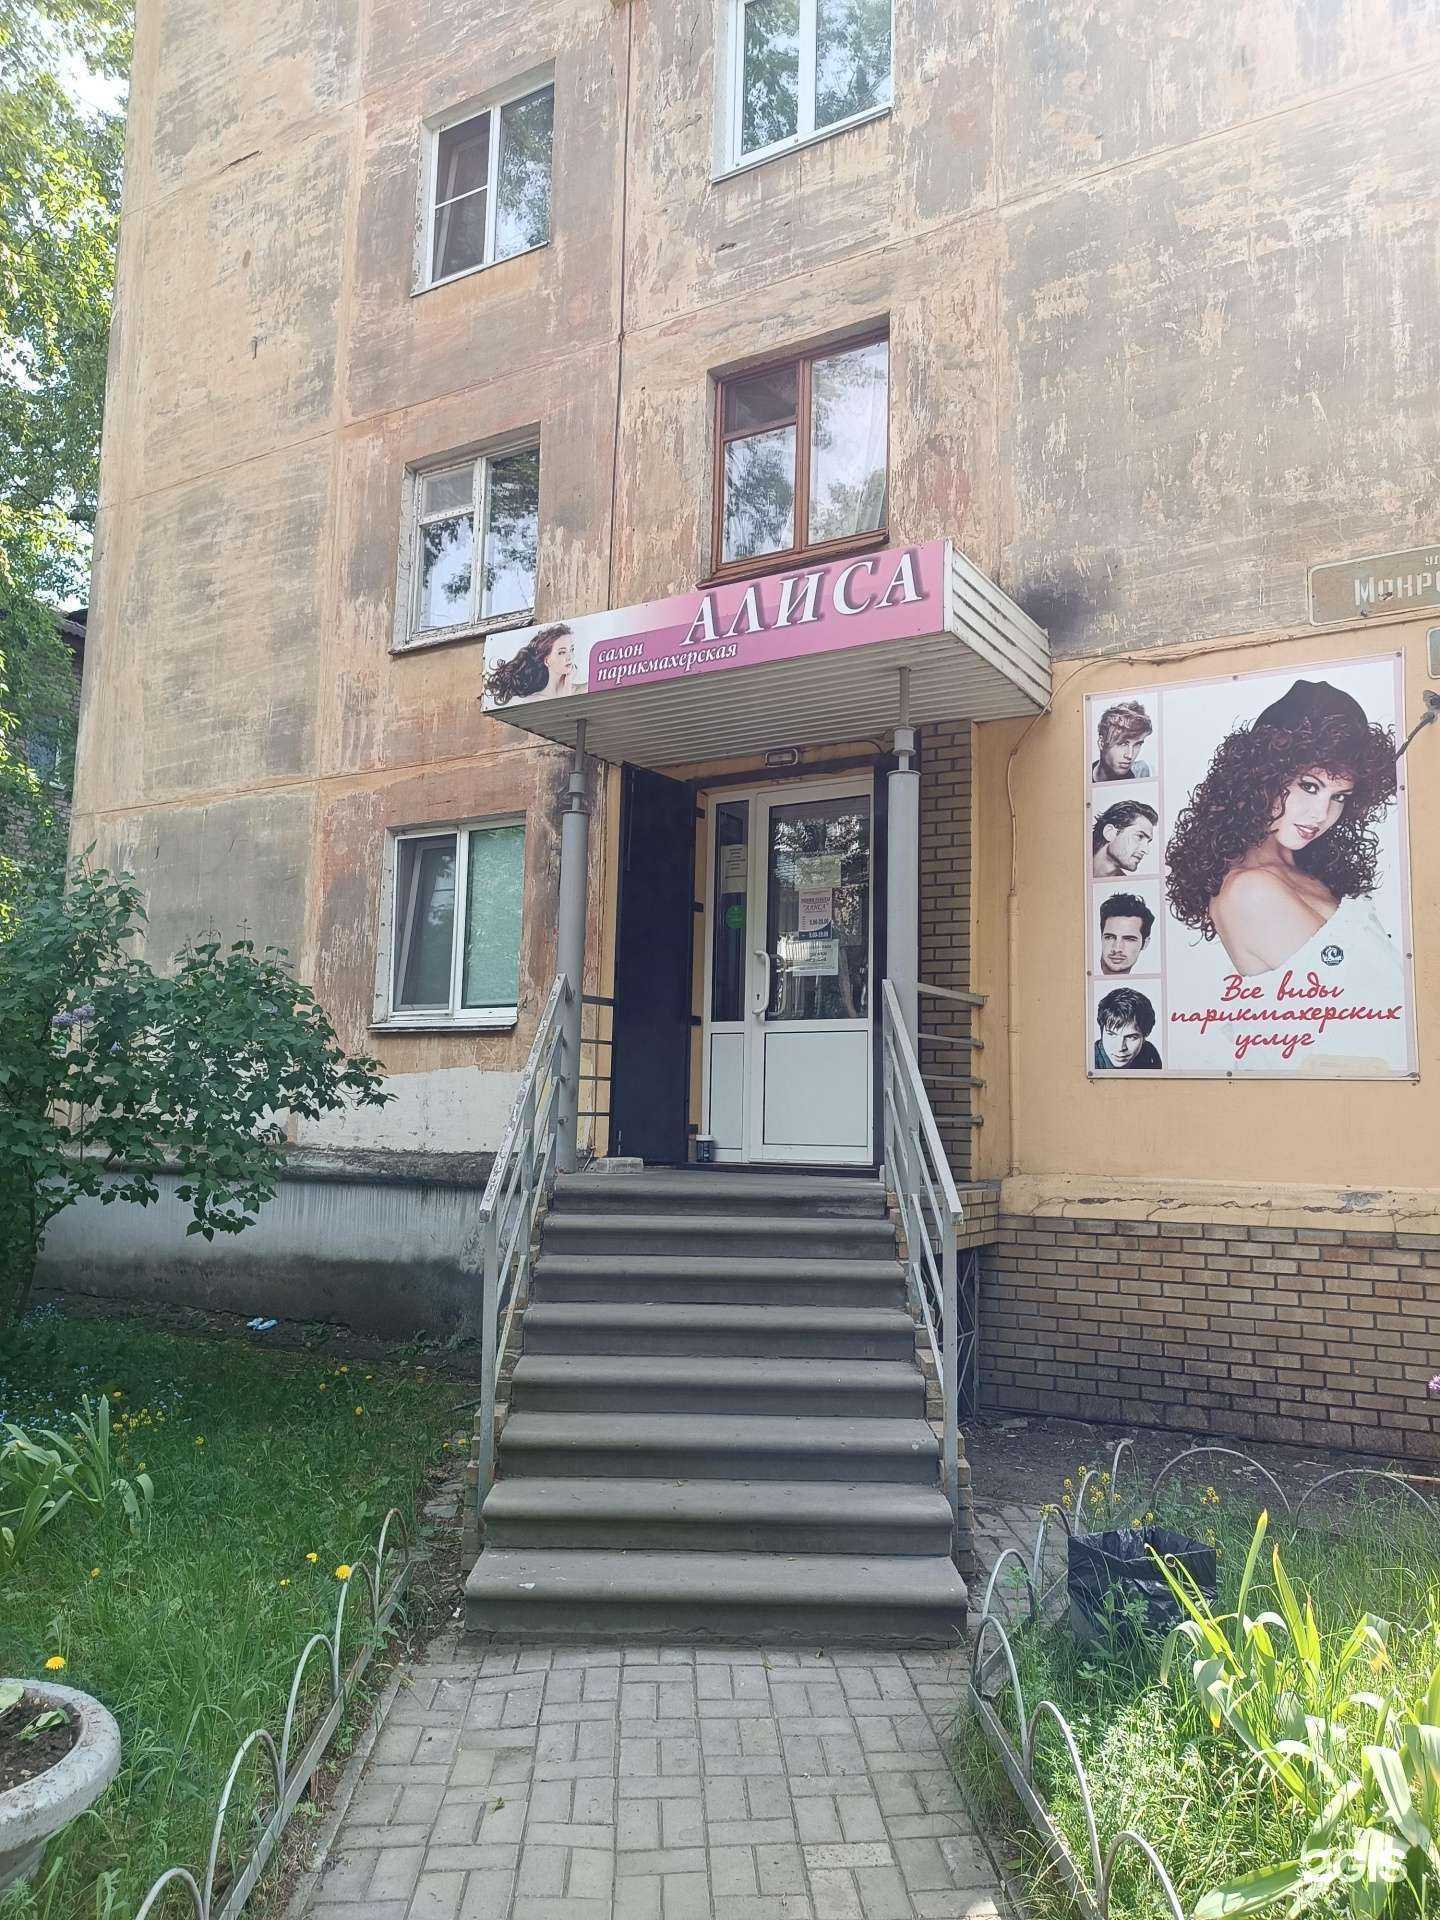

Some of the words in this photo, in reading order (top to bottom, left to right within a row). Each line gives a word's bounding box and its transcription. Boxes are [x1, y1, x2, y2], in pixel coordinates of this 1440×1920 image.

[679, 552, 925, 646] АЛИСА
[597, 643, 738, 685] парикмахерская
[598, 642, 645, 663] салон
[1220, 974, 1265, 1002] Все
[1276, 970, 1345, 1002] виды
[1170, 1004, 1403, 1035] парикмахерских
[1235, 1031, 1316, 1060] услуг
